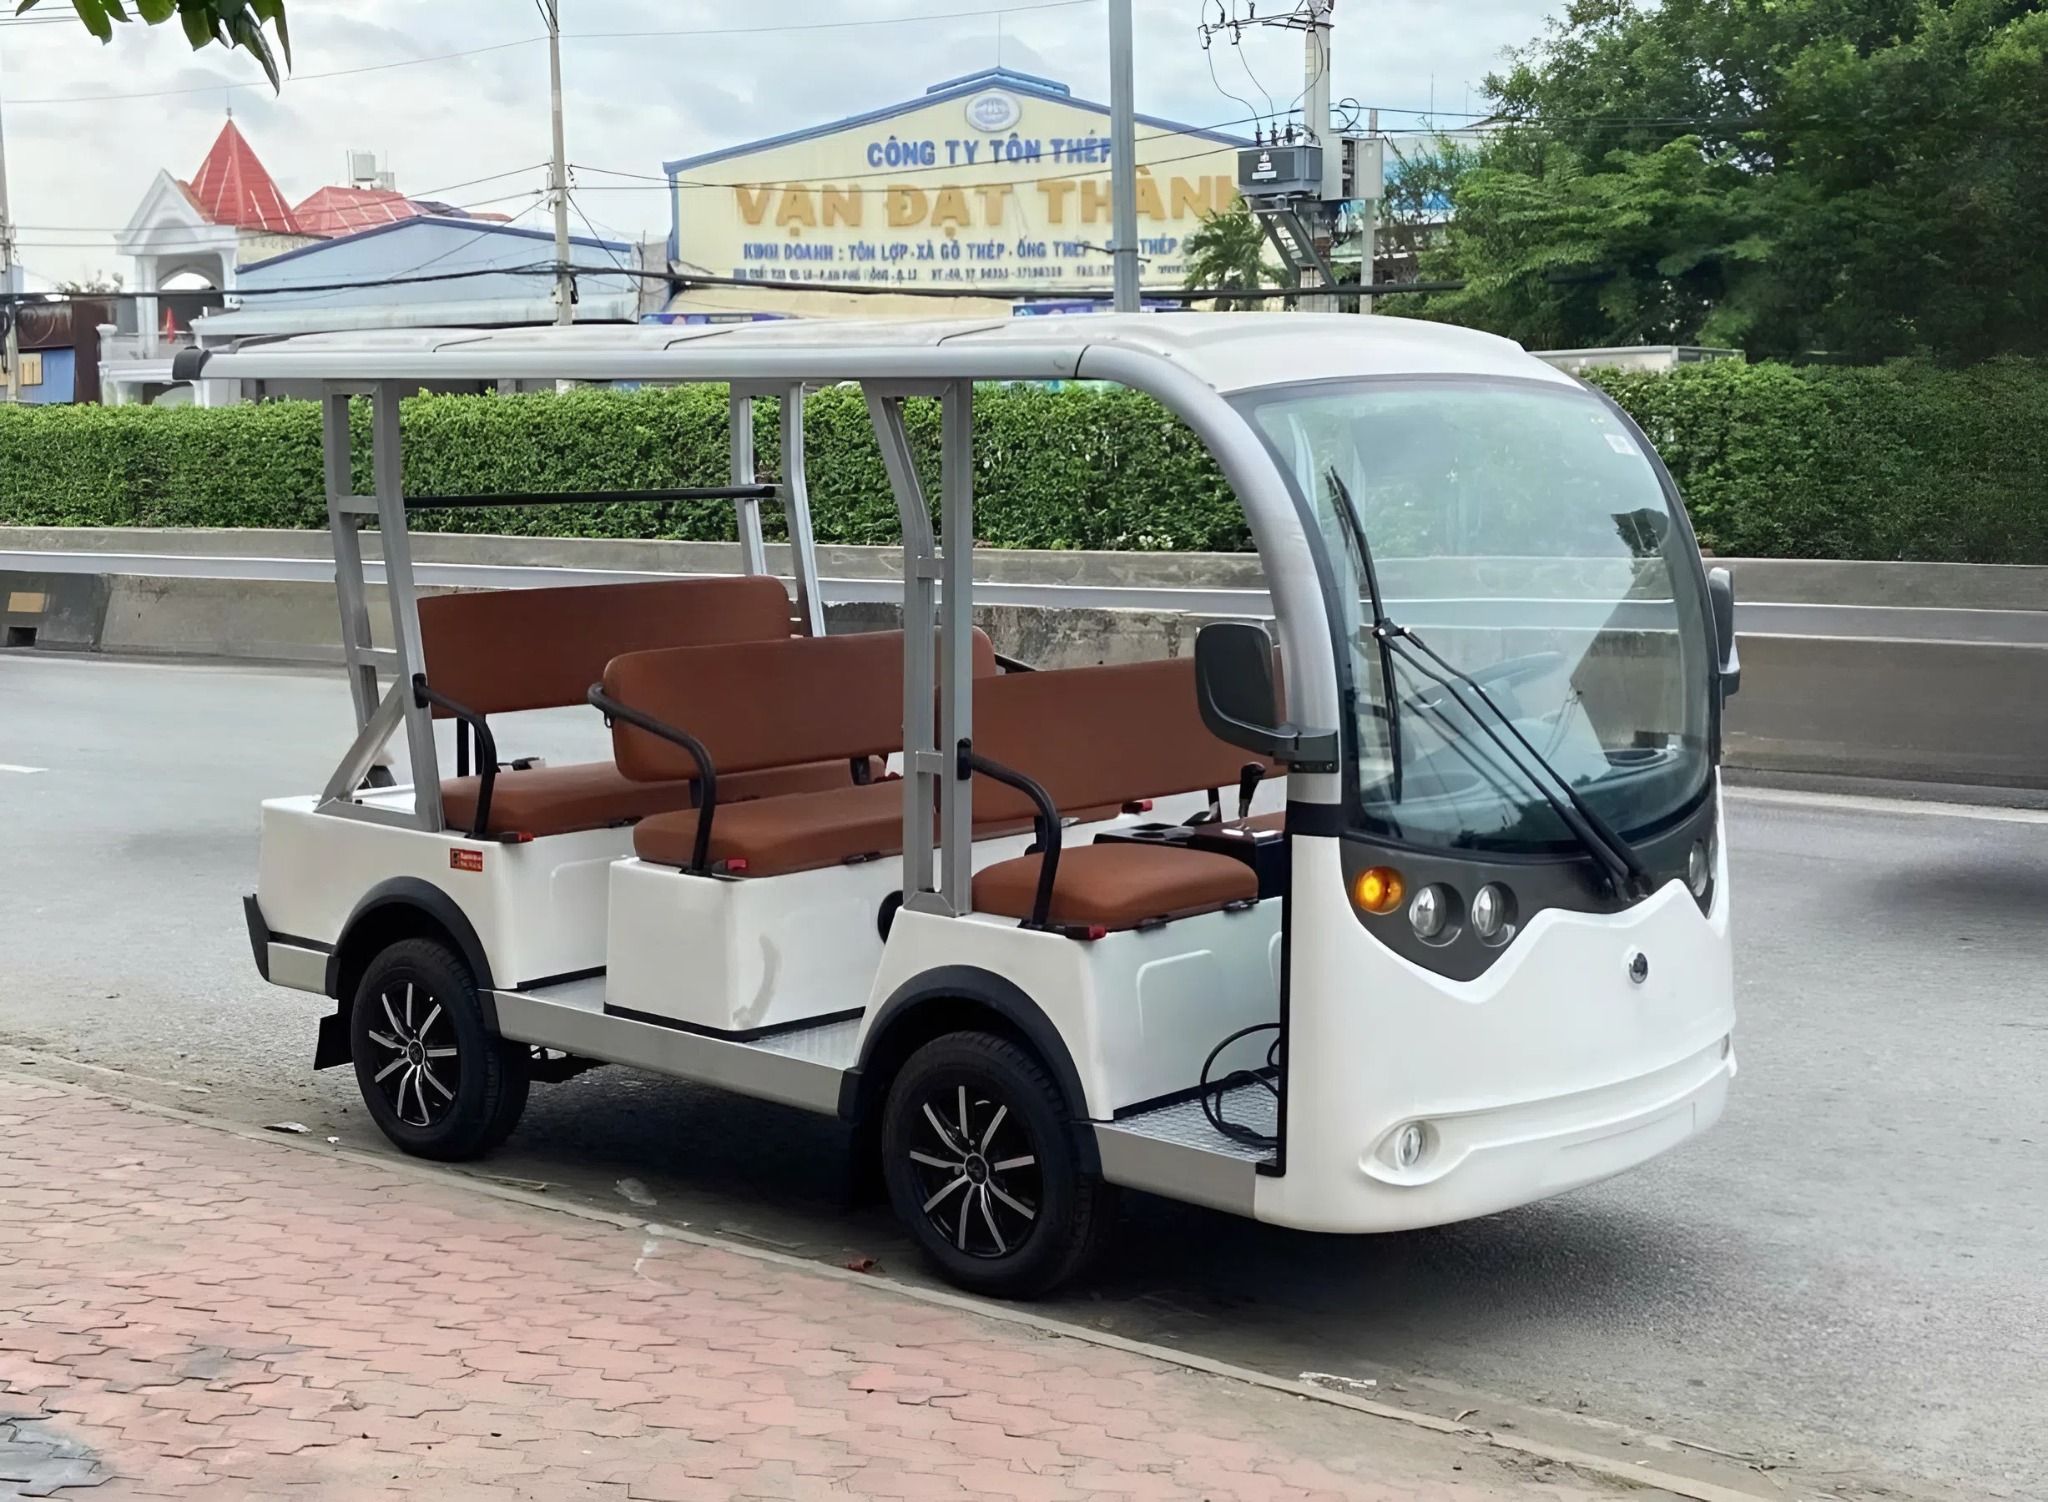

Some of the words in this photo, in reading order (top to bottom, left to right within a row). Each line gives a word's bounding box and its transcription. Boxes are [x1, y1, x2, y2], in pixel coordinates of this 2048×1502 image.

[867, 135, 935, 167] CÔNG
[945, 140, 979, 165] TY
[989, 132, 1040, 163] TÔN
[735, 184, 863, 237] VẠN
[883, 184, 1013, 238] ĐẠT
[848, 240, 875, 260] TÔN
[966, 239, 1005, 260] THÉP
